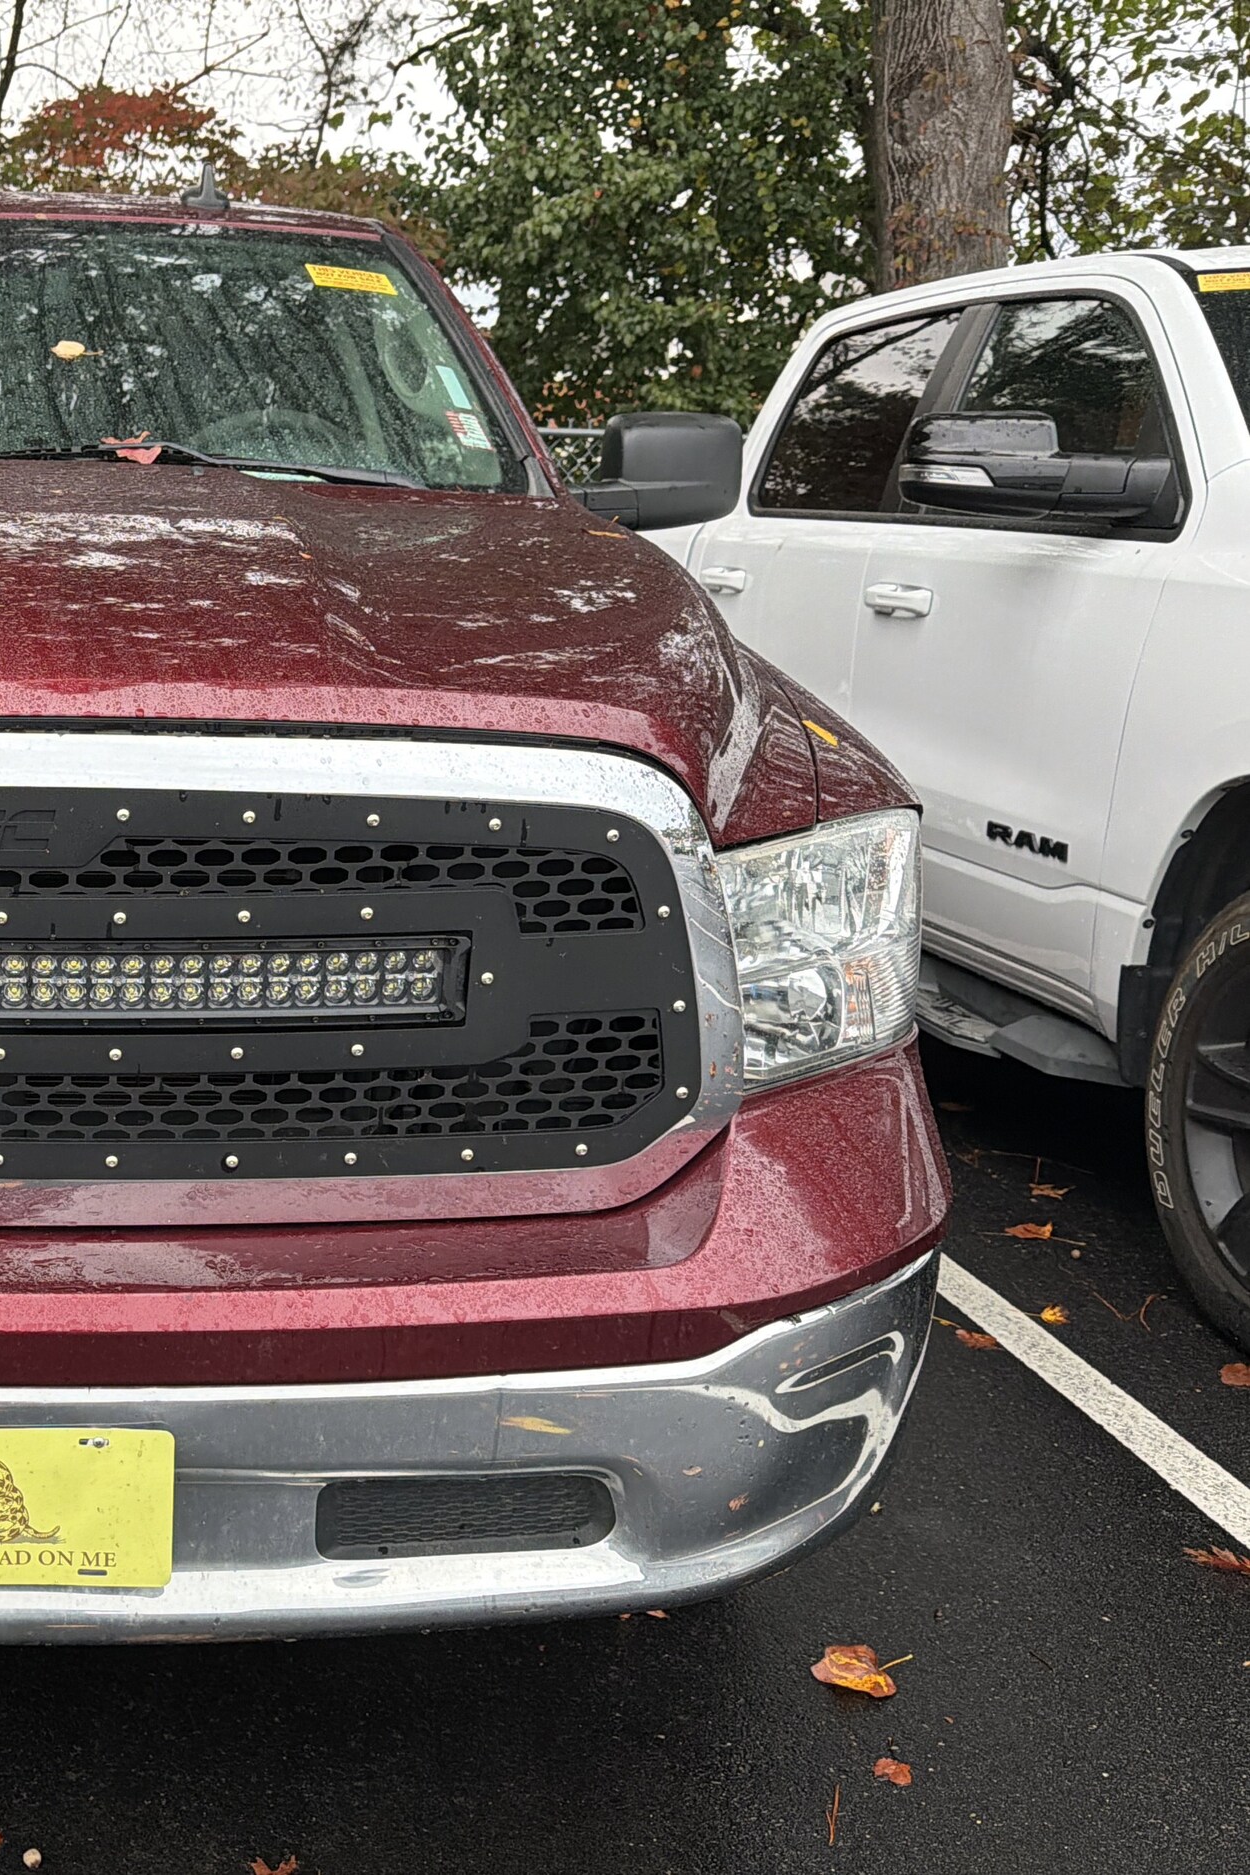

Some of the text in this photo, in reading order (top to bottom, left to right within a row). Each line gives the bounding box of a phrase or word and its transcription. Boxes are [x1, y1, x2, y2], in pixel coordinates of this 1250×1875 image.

[986, 820, 1069, 864] RAM
[1149, 987, 1187, 1209] DUELER
[38, 1550, 74, 1566] ON
[81, 1551, 116, 1567] ME
